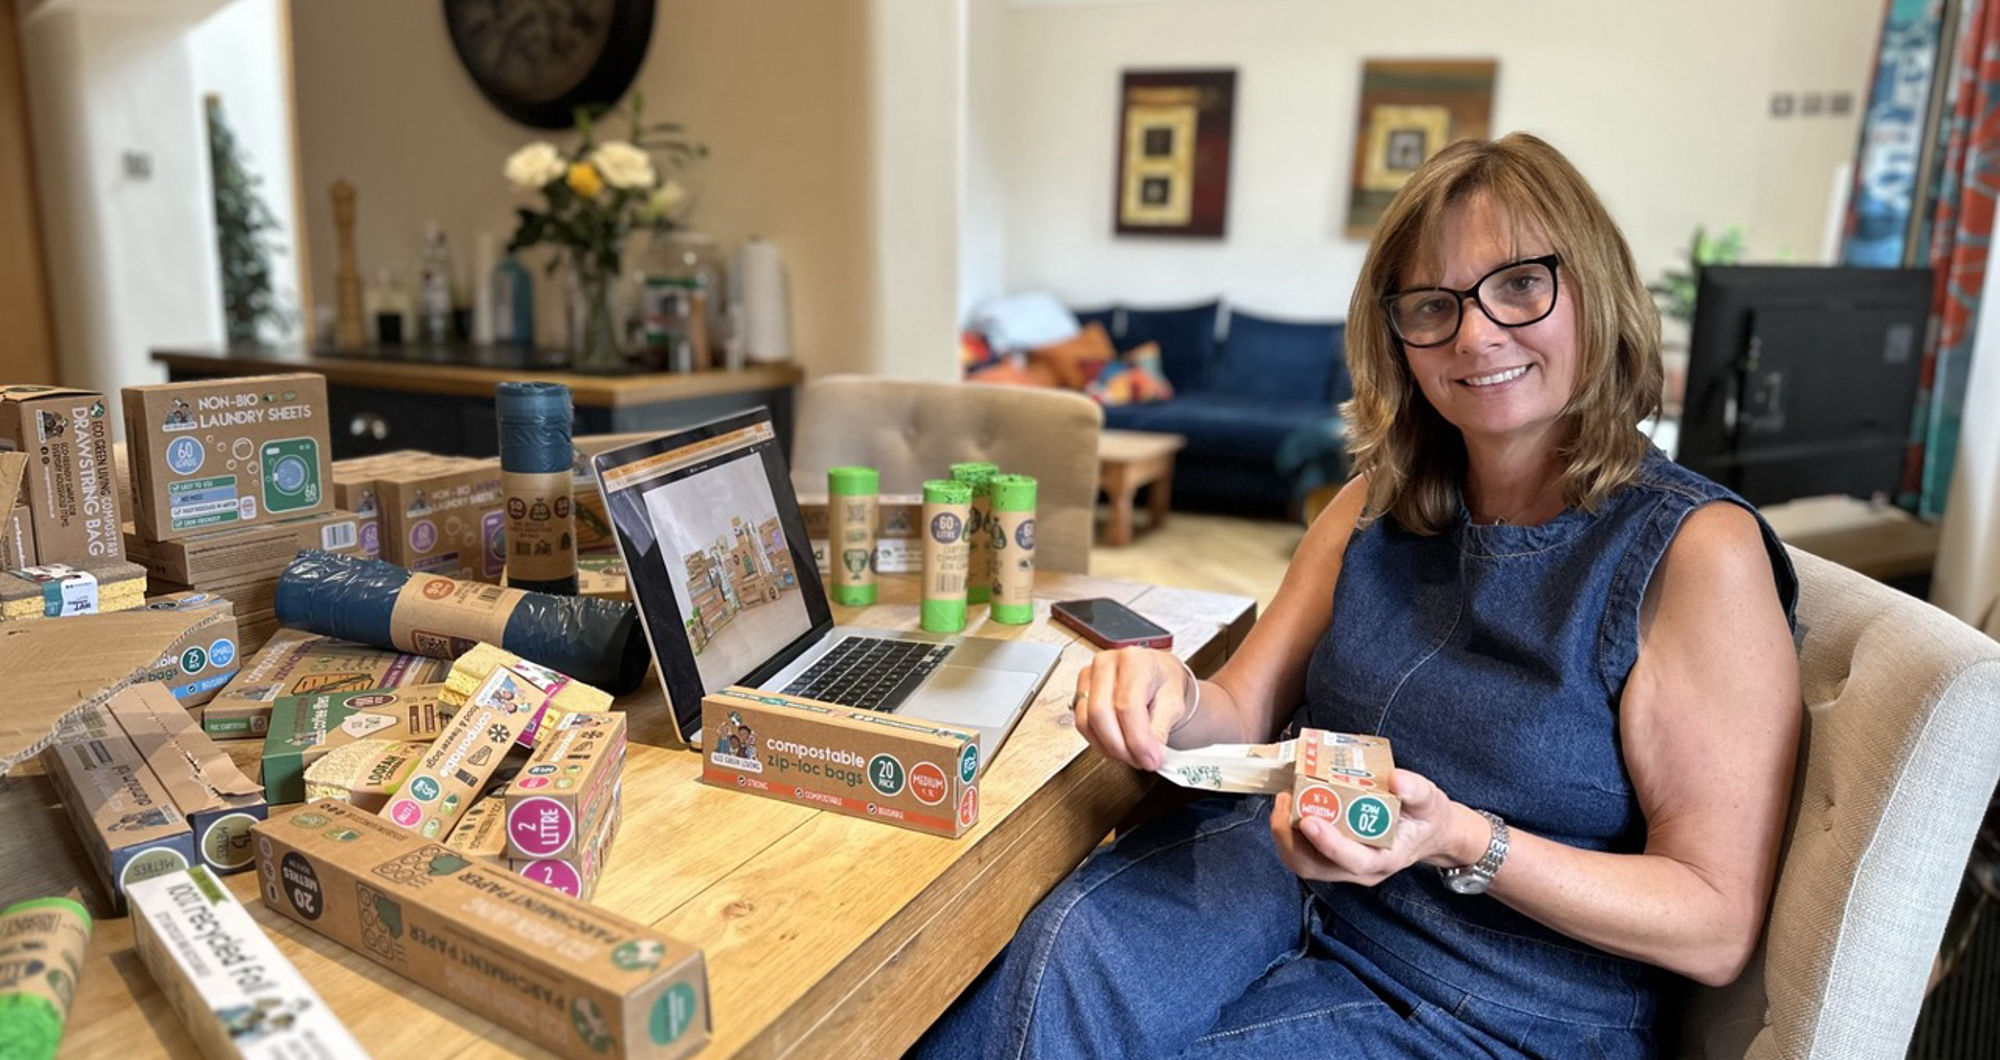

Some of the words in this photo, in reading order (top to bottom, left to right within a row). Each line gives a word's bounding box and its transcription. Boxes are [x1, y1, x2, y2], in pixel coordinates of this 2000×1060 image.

[198, 393, 259, 411] NON-BIO
[200, 409, 264, 428] LAUNDRY
[268, 405, 312, 421] SHEETS
[72, 406, 100, 515] DRAWSTRING
[177, 441, 193, 459] 60
[304, 483, 317, 498] 60
[938, 516, 955, 530] 60
[85, 519, 104, 556] BAG
[440, 711, 492, 777] compostable
[442, 725, 462, 751] freezer
[426, 750, 444, 769] bags
[766, 738, 866, 768] compostable
[767, 754, 820, 775] zip-loc
[825, 765, 863, 787] bags
[878, 760, 894, 778] 20
[878, 778, 895, 789] PACK
[912, 774, 943, 789] MEDIUM
[1302, 803, 1336, 818] MEDIUM
[1360, 803, 1380, 815] PACK
[518, 821, 536, 832] 2
[540, 808, 559, 845] LITRE
[1358, 813, 1379, 833] 20
[133, 857, 176, 877] METRES
[544, 866, 553, 883] 2
[283, 867, 318, 893] METRES
[458, 872, 514, 900] PAPER
[294, 887, 315, 913] 20
[513, 894, 622, 943] PARCHMENT
[182, 904, 256, 966] recycled
[409, 924, 458, 959] PAPER
[461, 949, 565, 1011] PARCHMENT
